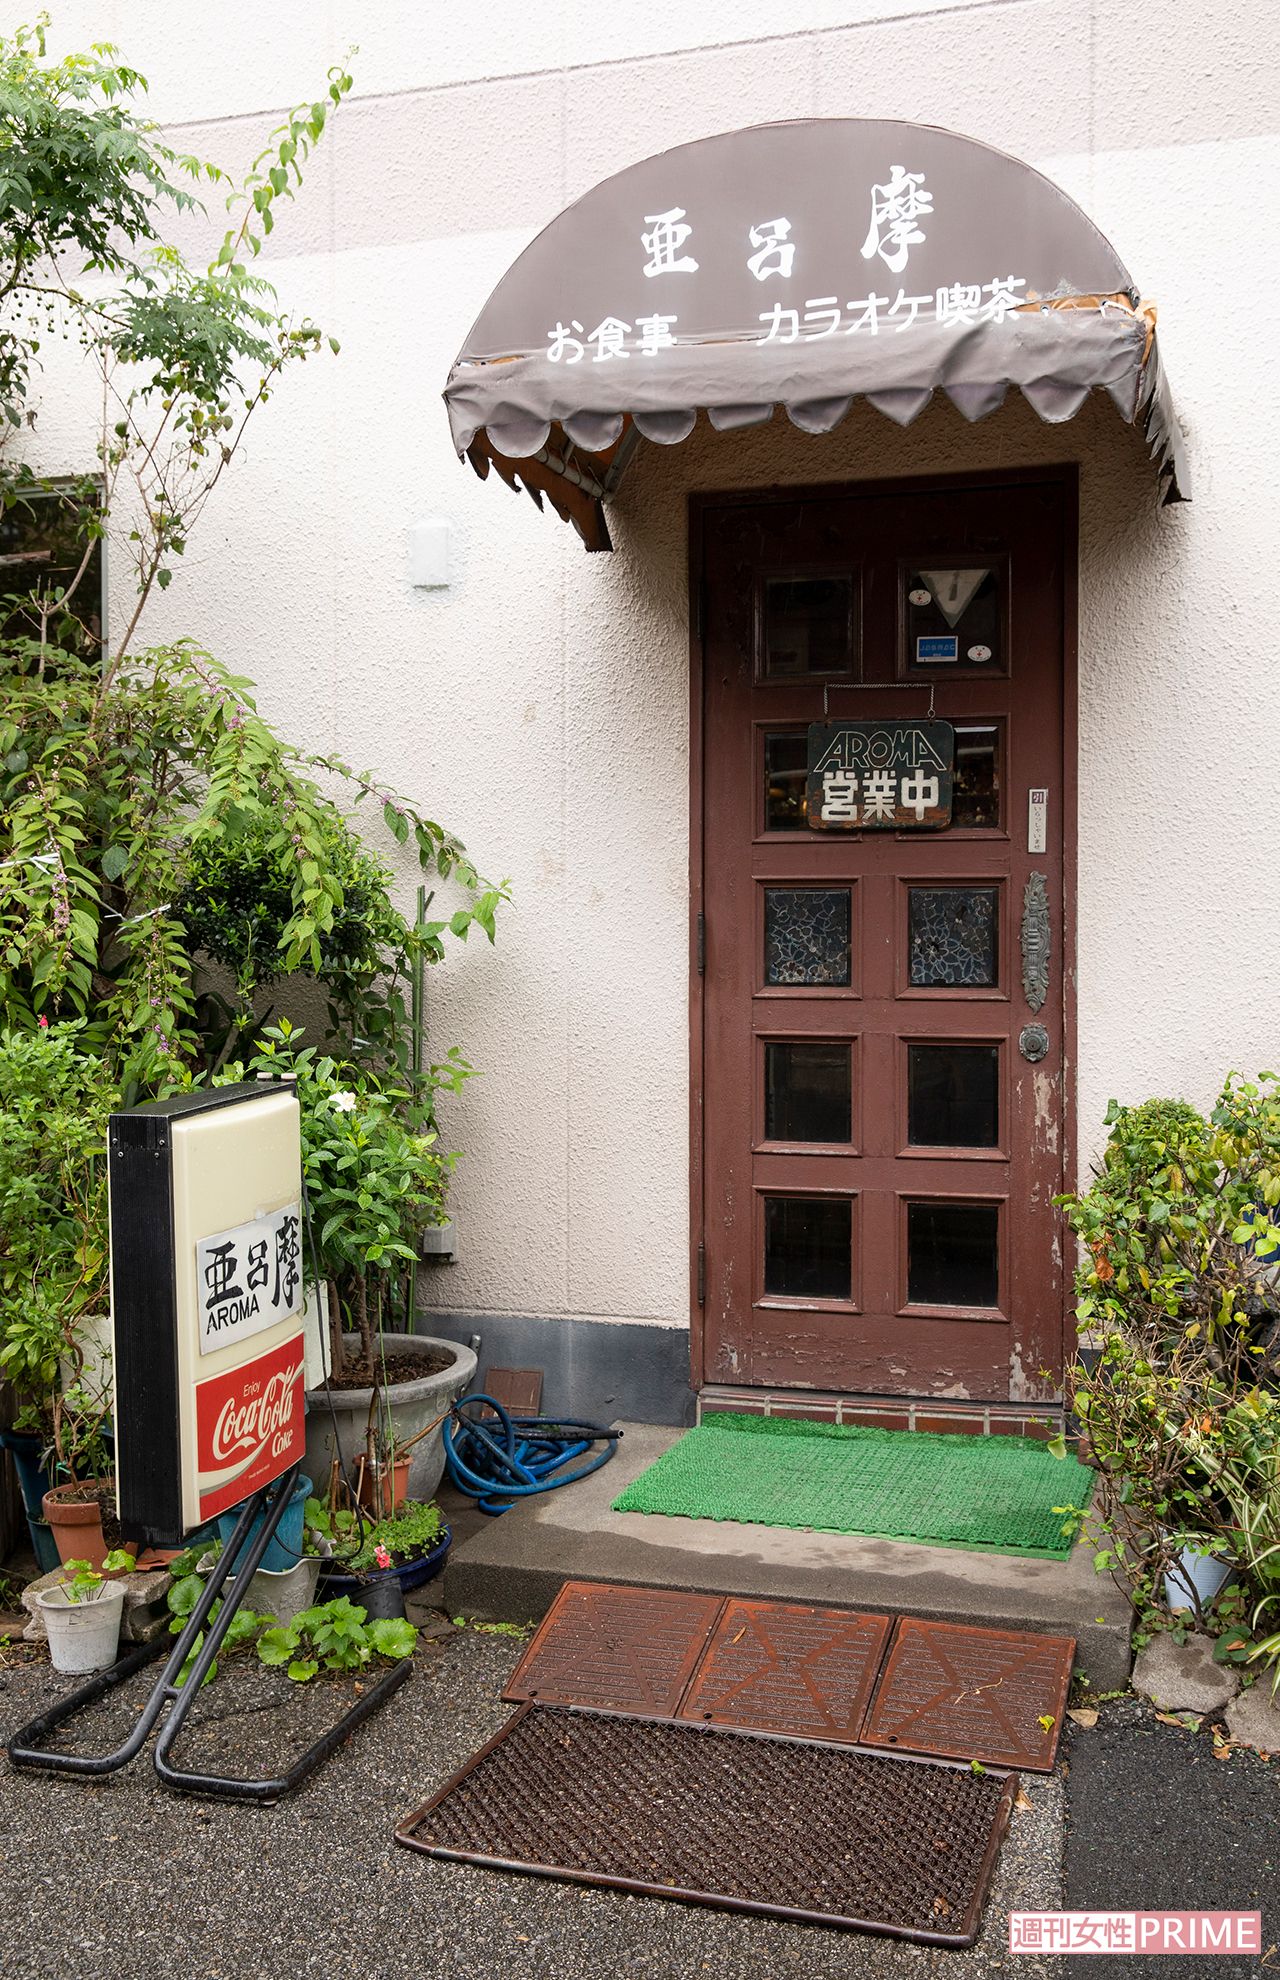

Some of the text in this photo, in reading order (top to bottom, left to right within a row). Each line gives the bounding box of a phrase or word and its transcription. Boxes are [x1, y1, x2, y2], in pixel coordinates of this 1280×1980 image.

[546, 275, 1027, 365] お食事 カラオケ喫茶
[813, 731, 947, 772] AROMA
[821, 769, 939, 821] 営業中
[204, 1215, 300, 1310] 亜呂摩
[206, 1293, 260, 1335] AROMA
[212, 1362, 295, 1461] Coca-Cola
[243, 1380, 261, 1397] Enjoy
[271, 1429, 293, 1458] Coke
